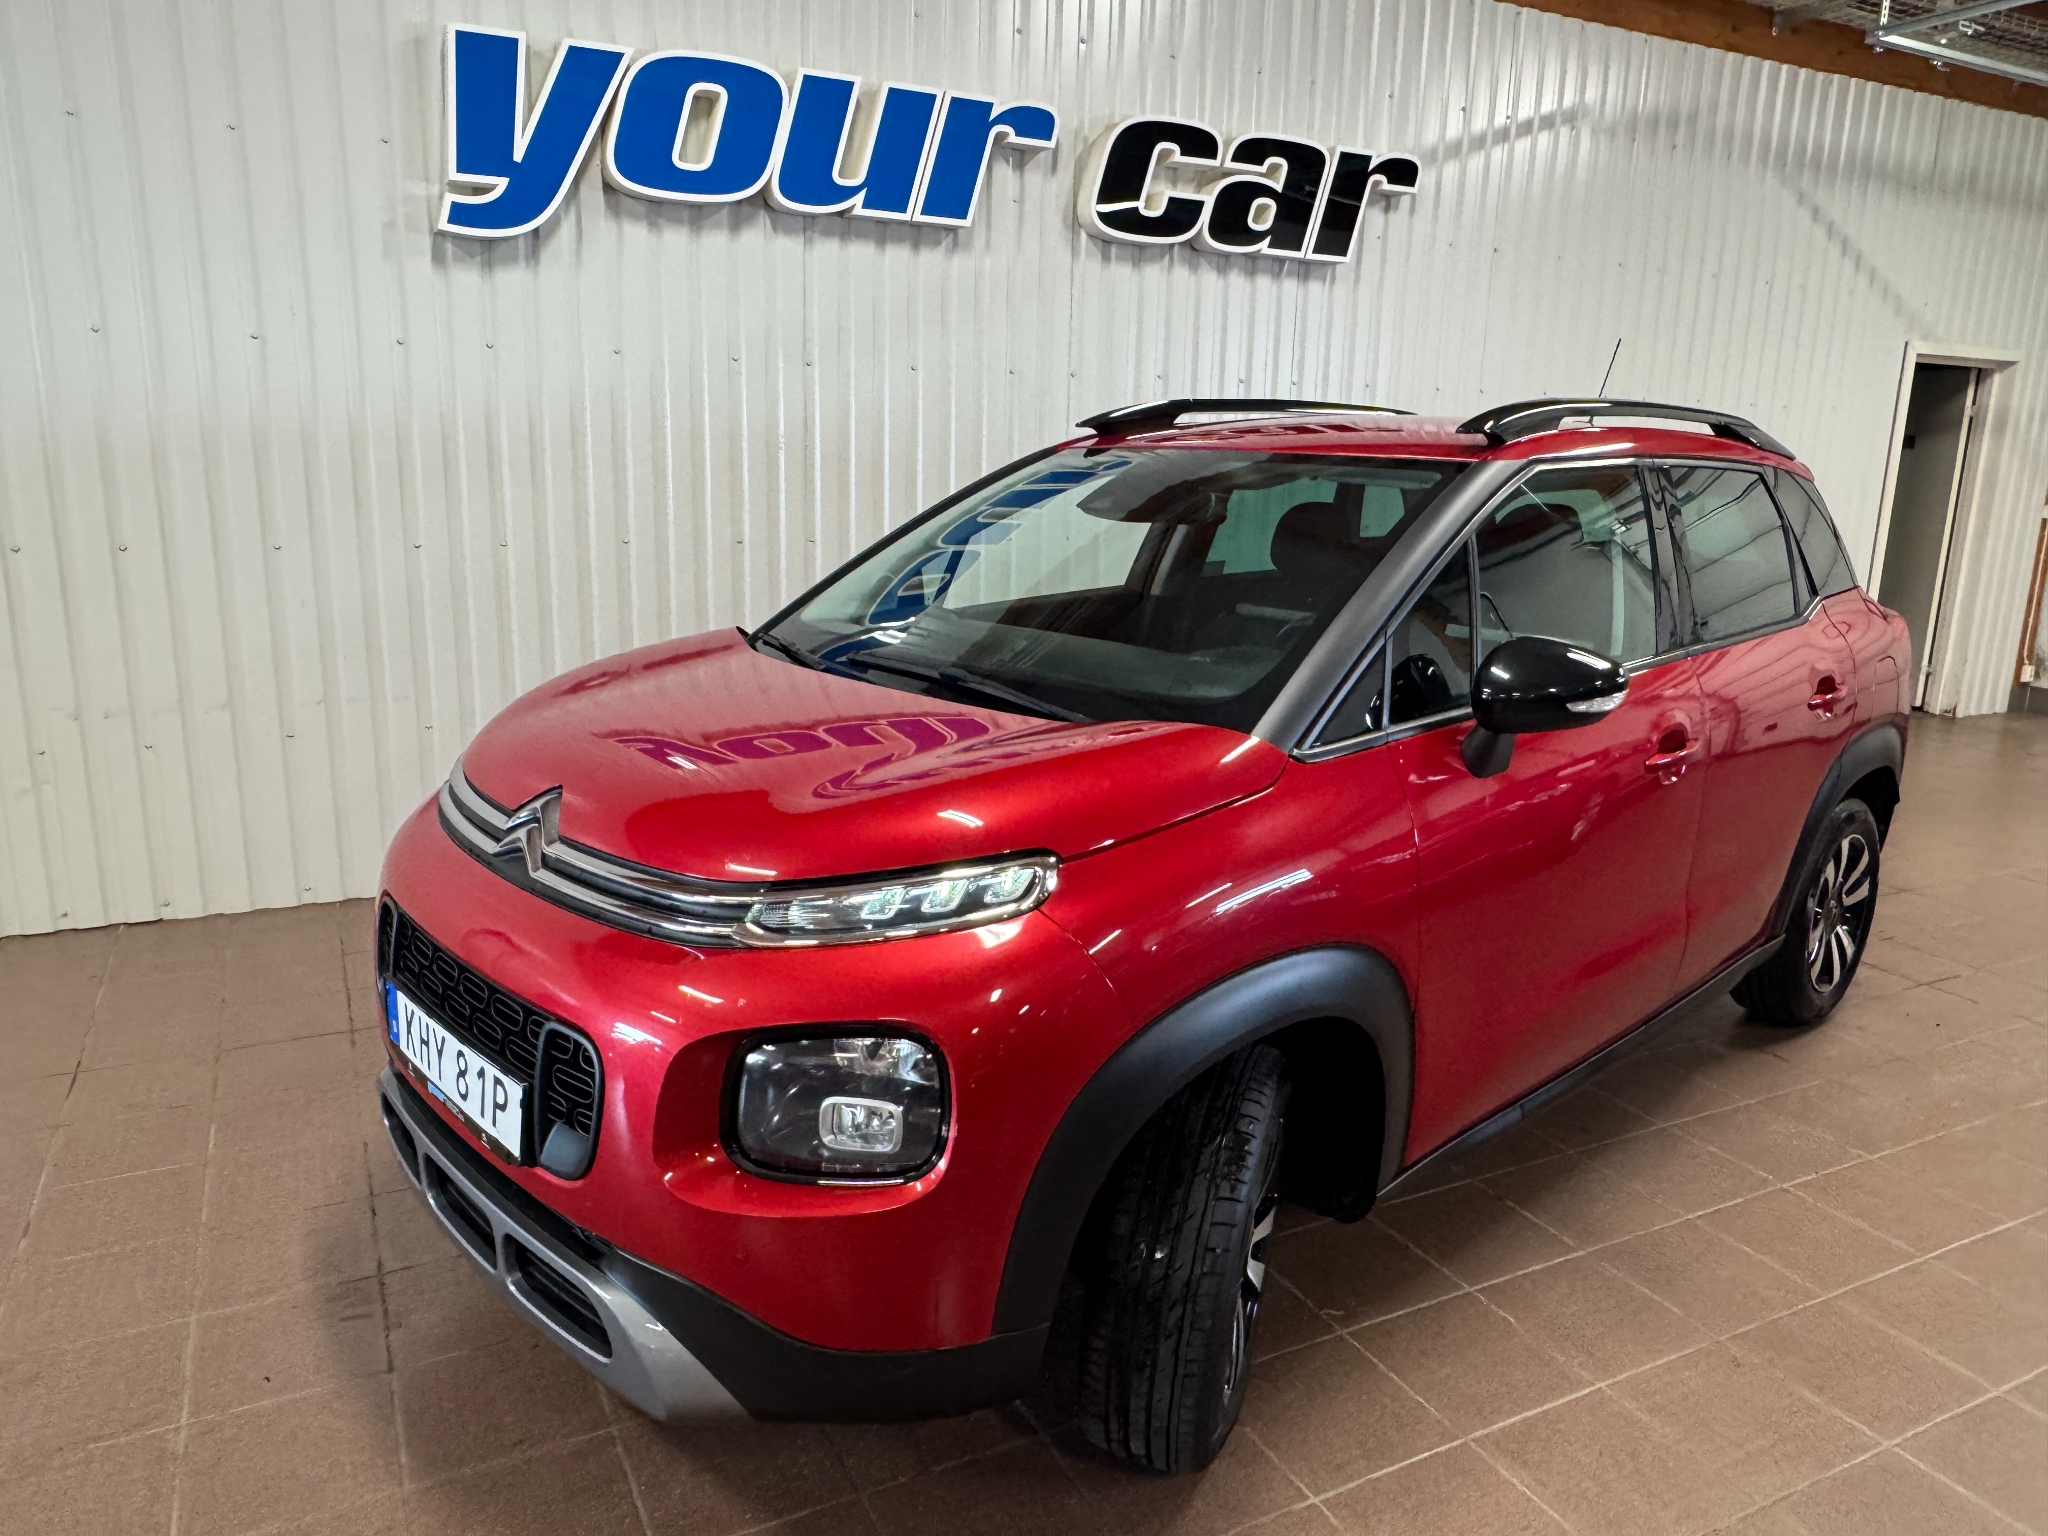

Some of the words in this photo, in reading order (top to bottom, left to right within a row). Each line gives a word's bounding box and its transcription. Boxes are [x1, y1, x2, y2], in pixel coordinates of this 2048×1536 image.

[438, 25, 1057, 239] your
[1084, 115, 1419, 263] car
[404, 1002, 446, 1082] KHY
[456, 1049, 508, 1129] 81P
